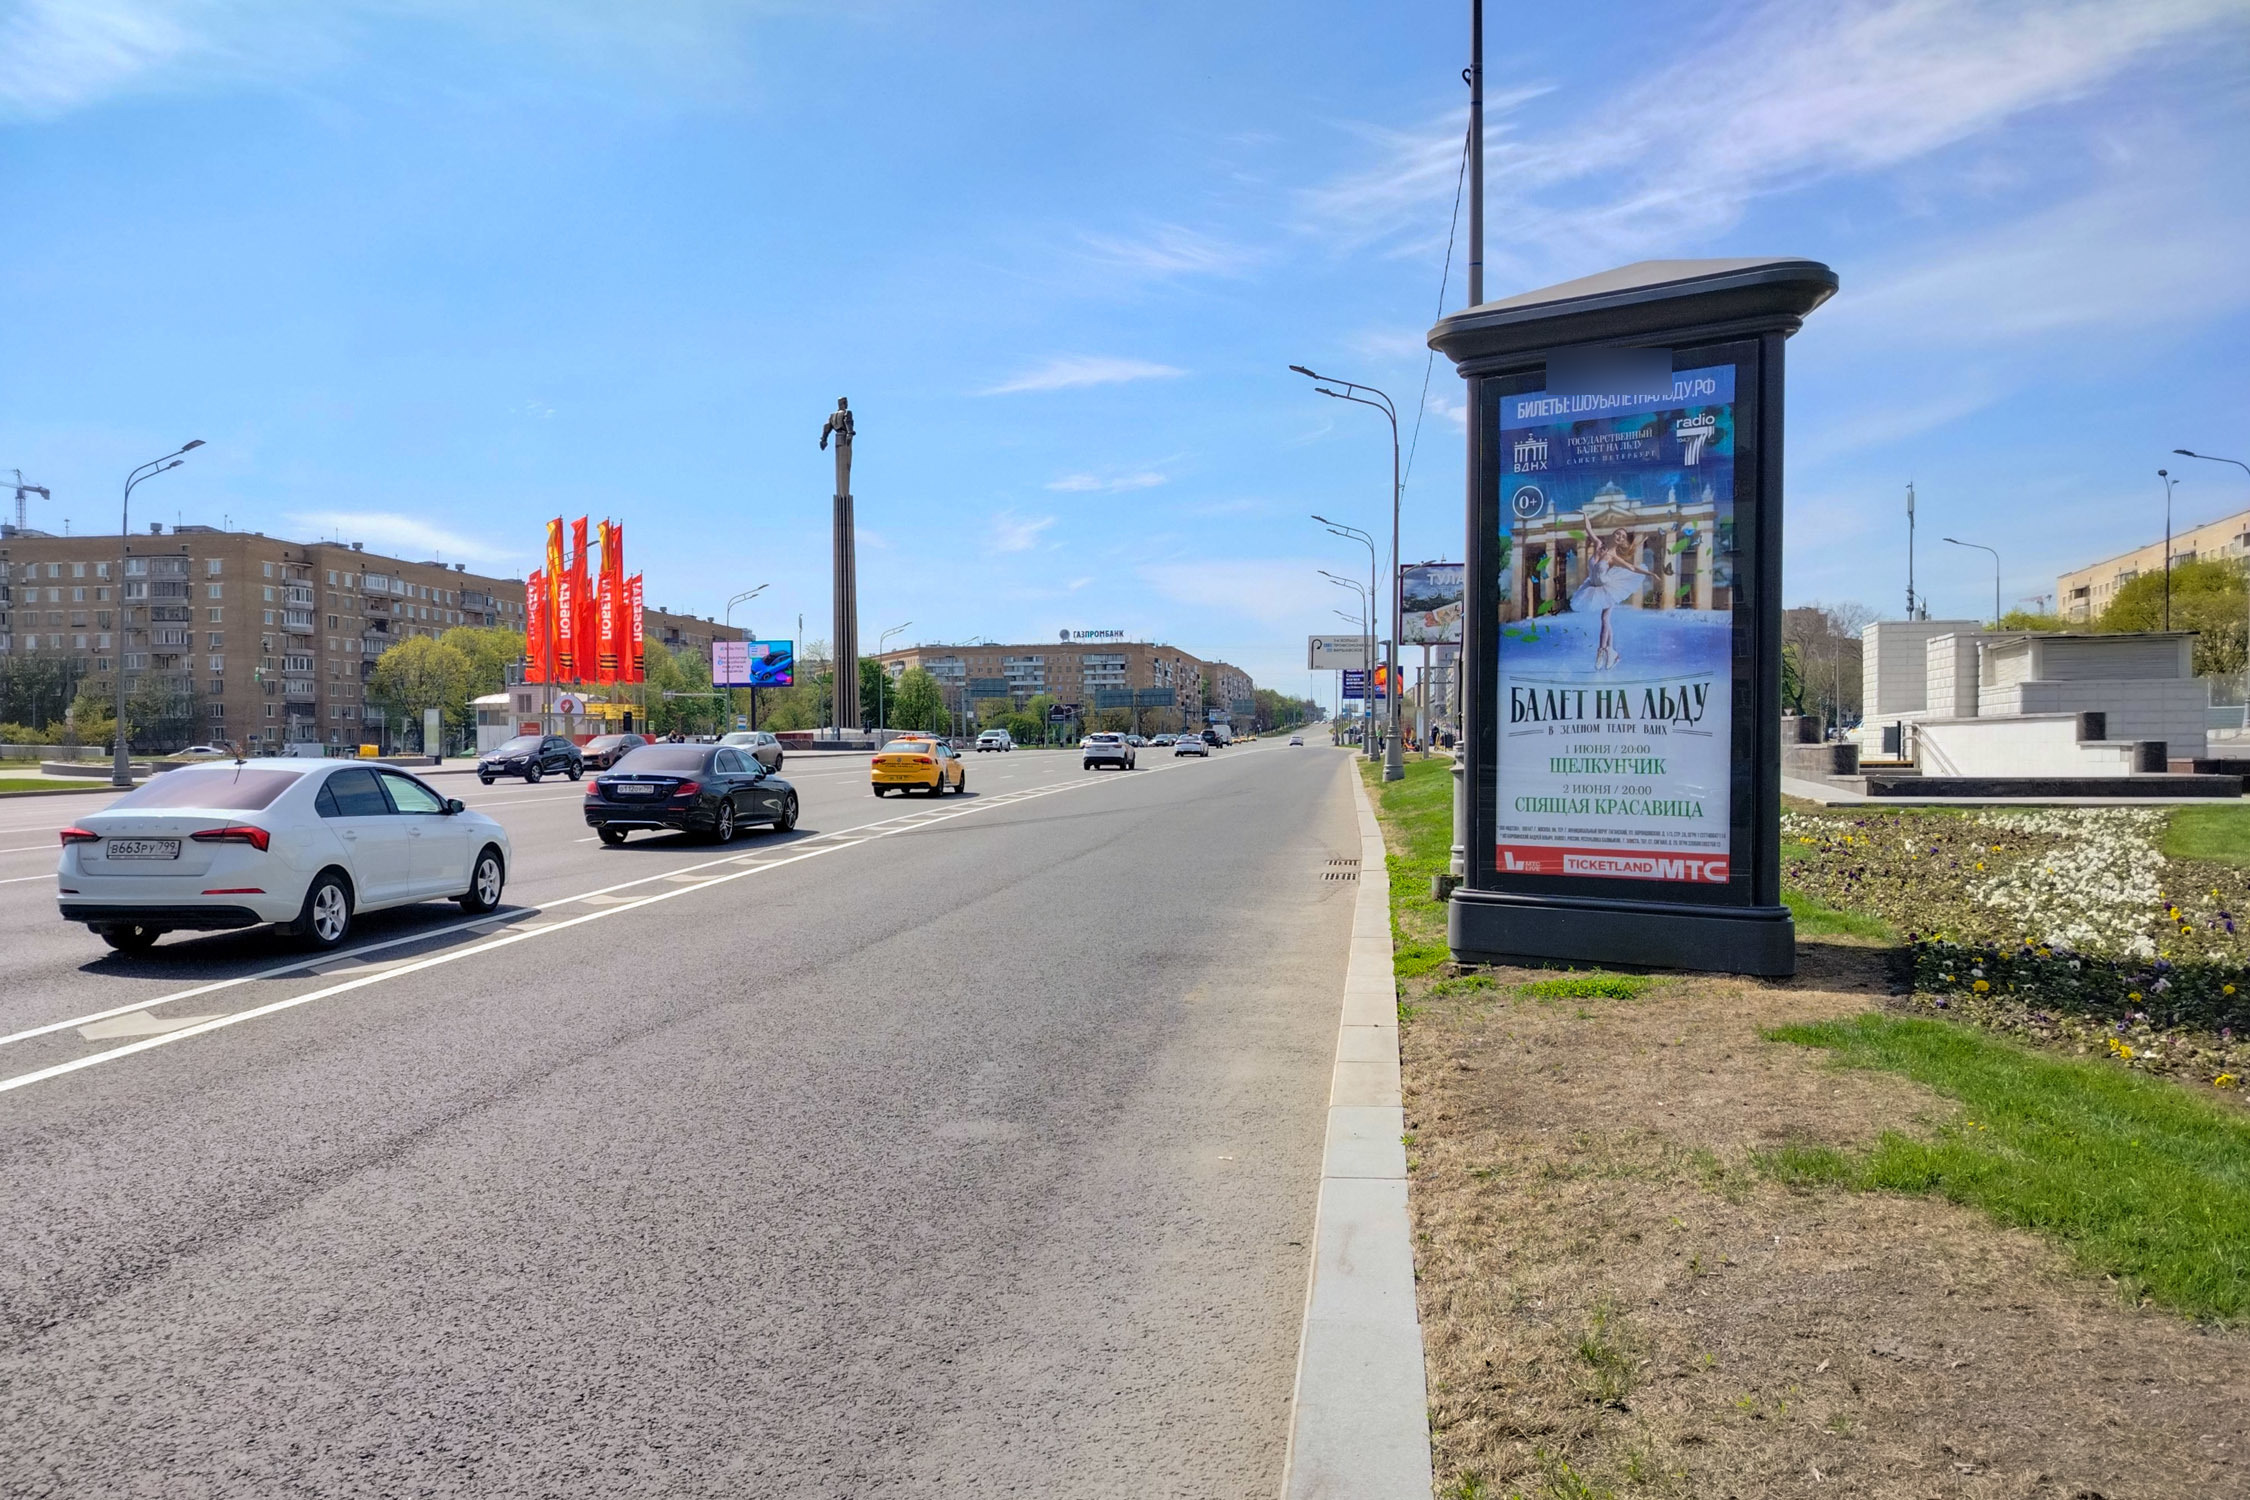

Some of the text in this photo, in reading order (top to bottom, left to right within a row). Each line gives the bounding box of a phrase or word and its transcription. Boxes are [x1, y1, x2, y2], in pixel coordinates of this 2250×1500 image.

[1517, 397, 1570, 420] БИЛЕТЫ:
[1676, 413, 1715, 429] radio
[1567, 427, 1653, 447] ГОСУДАРСТВЕННЫЙ
[1576, 440, 1643, 455] БАЛЕТ НА ЛЬДУ
[1514, 461, 1548, 473] ВДНХ
[1519, 495, 1538, 509] 0+
[1073, 630, 1124, 638] ГАЗПРОМБАНК
[1510, 683, 1710, 727] БАЛЕТ НА ЛЬДУ
[1548, 724, 1668, 736] В ЗЕЛЕНОМ ТЕАТРЕ ВДНХ
[1565, 745, 1570, 754] 1
[1574, 745, 1611, 754] ИЮНЯ
[1621, 745, 1650, 754] 20:00
[1550, 758, 1667, 776] ЩЕЛКУНЧИК
[1562, 784, 1652, 795] 2 ИЮНЯ / 20:00
[1515, 797, 1704, 820] СПЯЩАЯ КРАСАВИЦА
[111, 841, 175, 854] В663РУ 799
[1568, 859, 1653, 873] TICKETLAND
[1658, 858, 1727, 882] МТС
